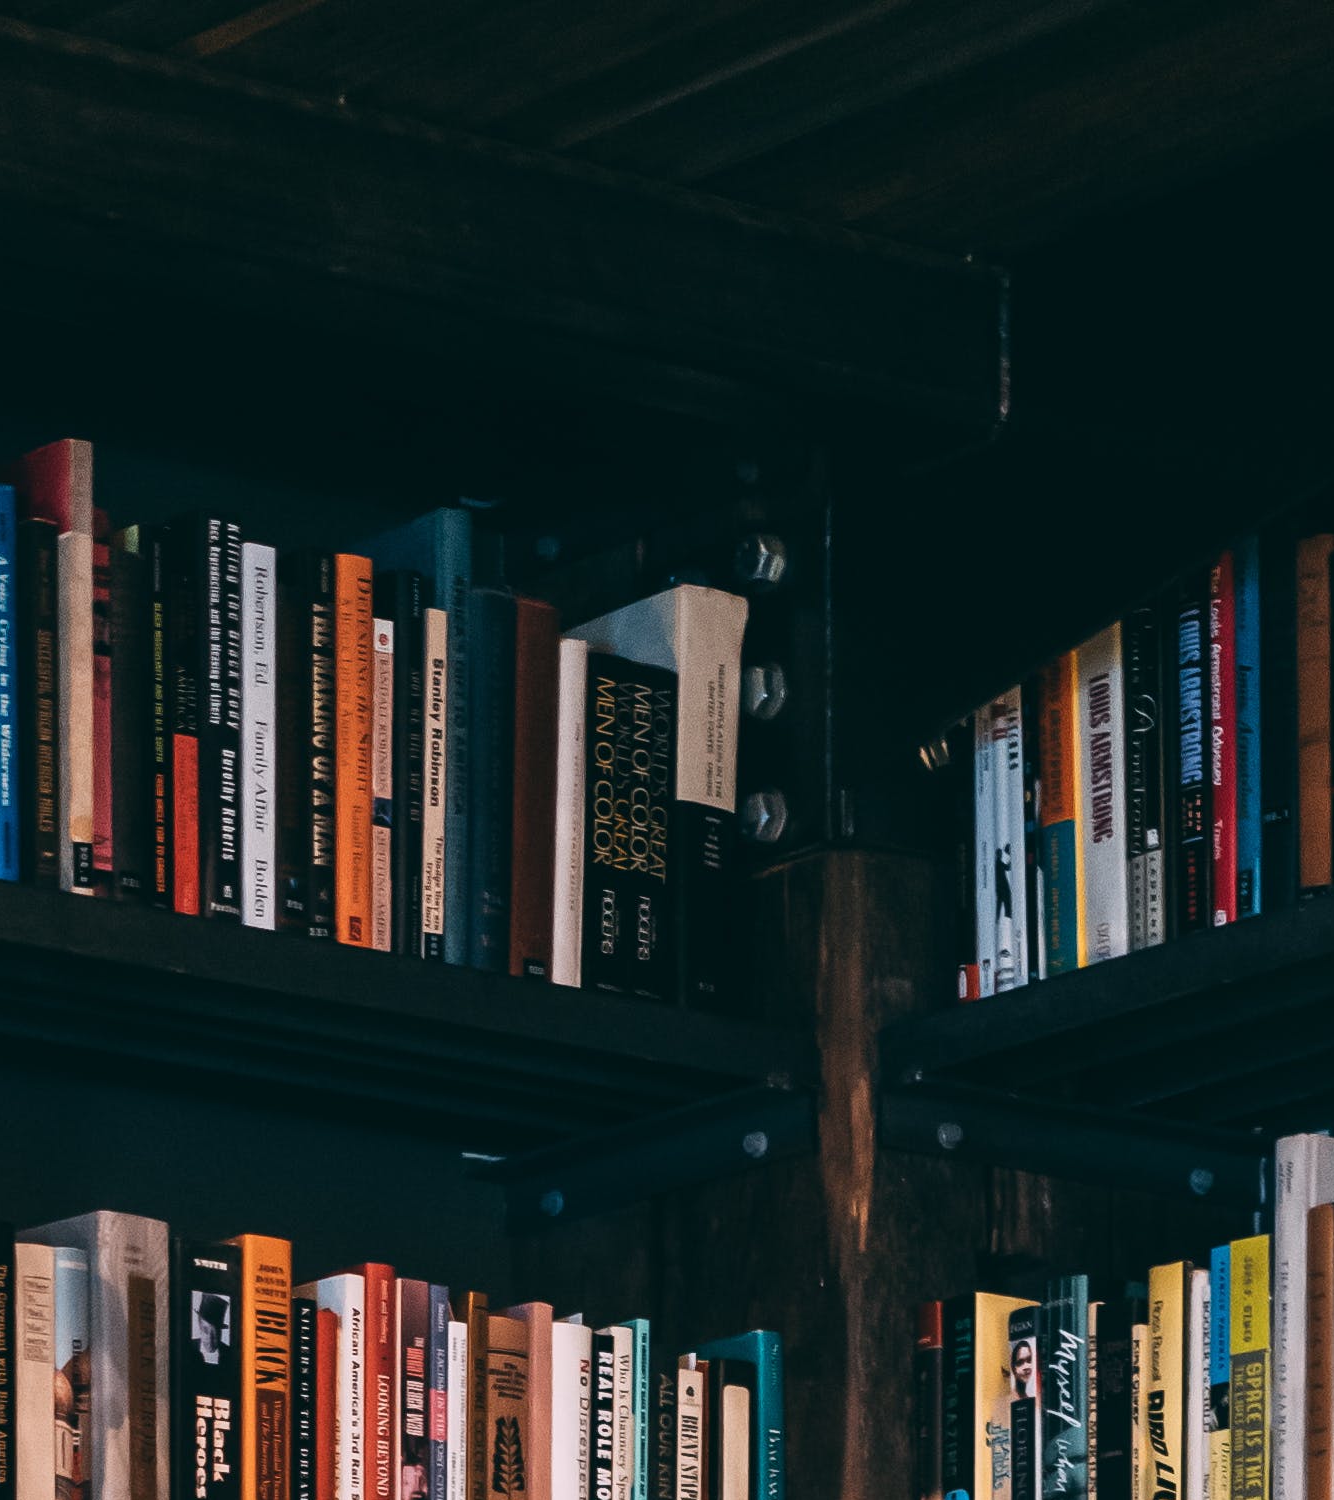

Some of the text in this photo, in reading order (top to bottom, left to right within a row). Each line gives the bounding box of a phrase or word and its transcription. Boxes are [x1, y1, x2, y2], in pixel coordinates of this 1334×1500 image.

[251, 719, 270, 833] Family Affair
[593, 677, 616, 865] MEN OF COLOR
[630, 685, 651, 873] MEN OF COLOR
[254, 859, 270, 919] Bolden
[253, 1309, 289, 1388] BLACK
[597, 1351, 613, 1400] REAL
[194, 1395, 211, 1499] Heroes
[211, 1398, 230, 1483] Black
[597, 1405, 612, 1462] ROLE
